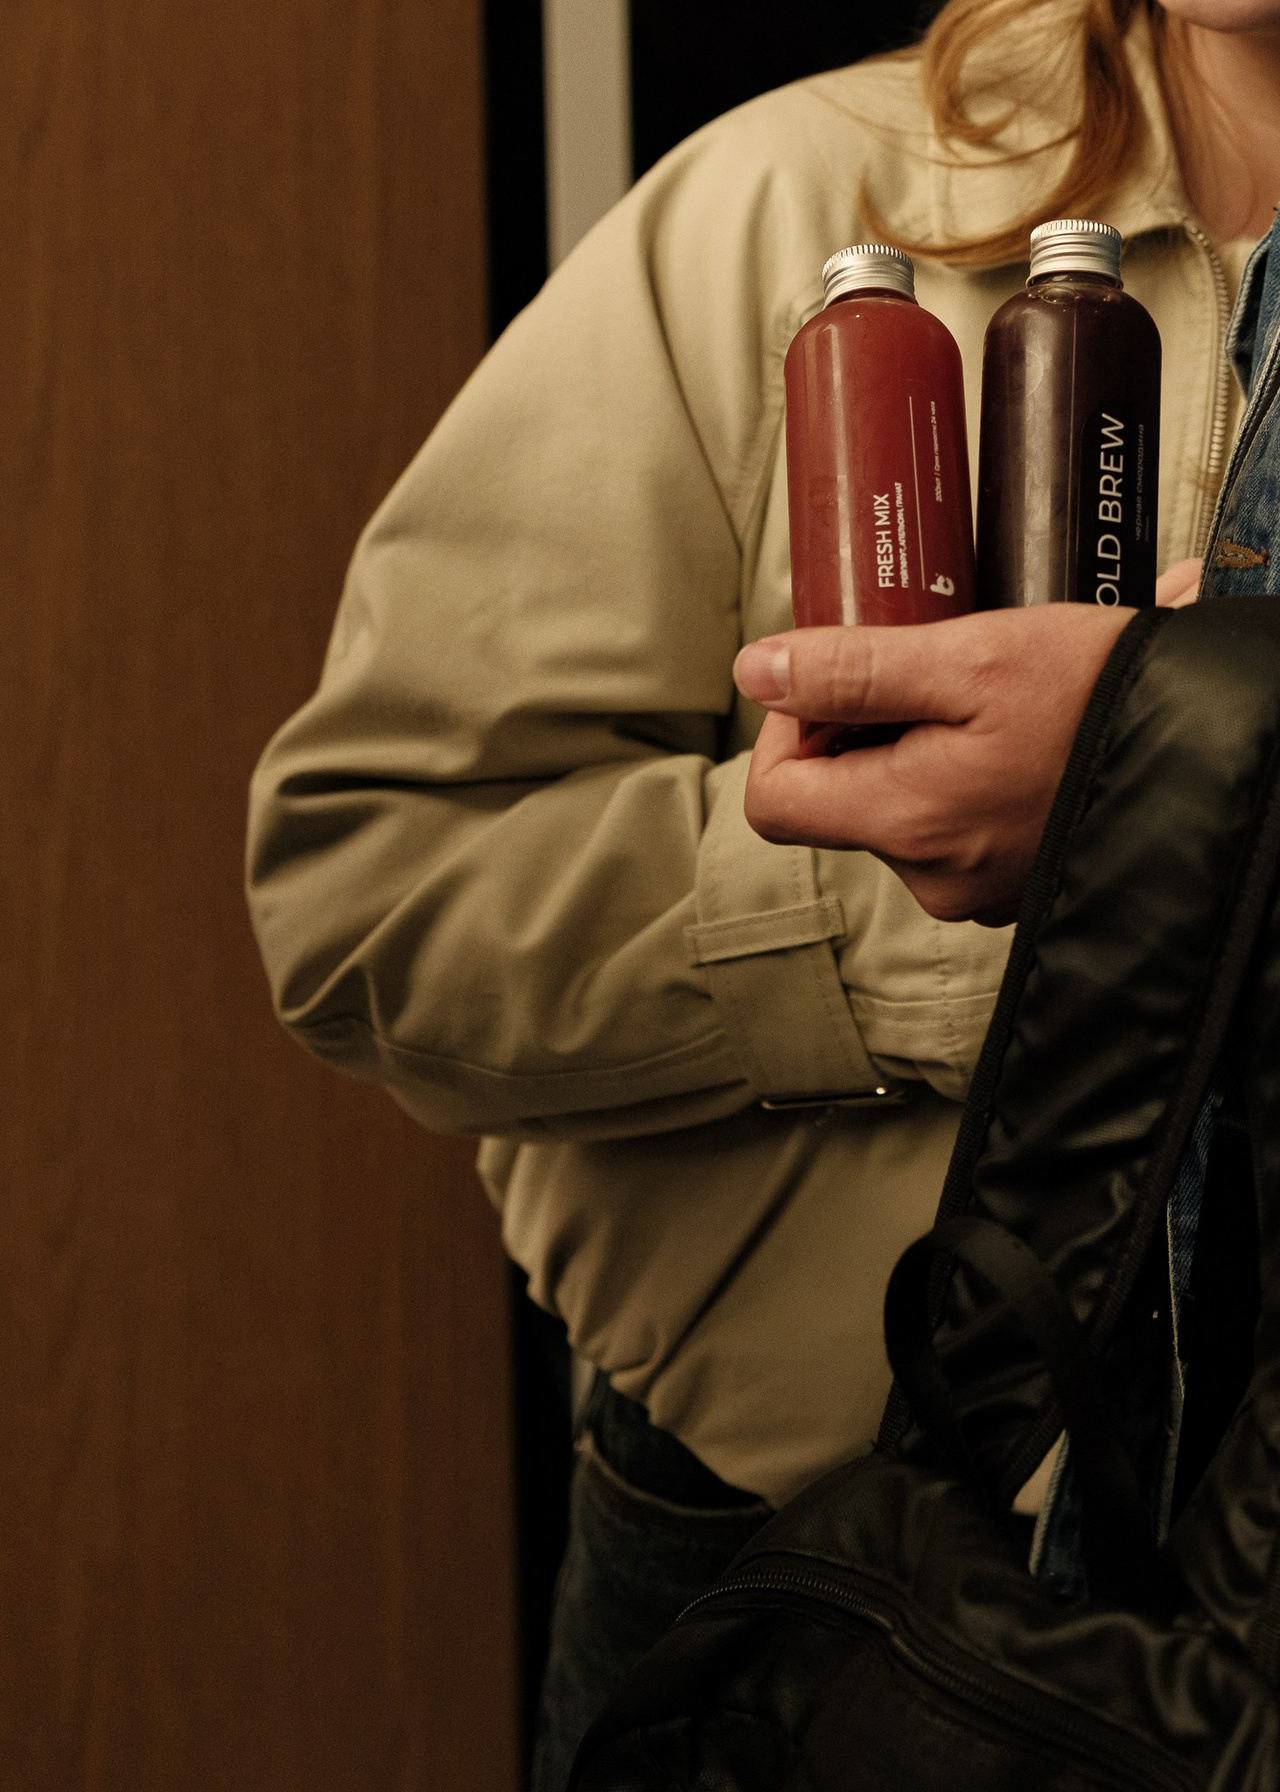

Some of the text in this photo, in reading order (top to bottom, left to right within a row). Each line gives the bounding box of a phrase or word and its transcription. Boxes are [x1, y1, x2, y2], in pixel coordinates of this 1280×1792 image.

[1136, 423, 1145, 494] смородина
[872, 493, 895, 588] FRESH MIX
[1095, 412, 1124, 607] OLD BREW
